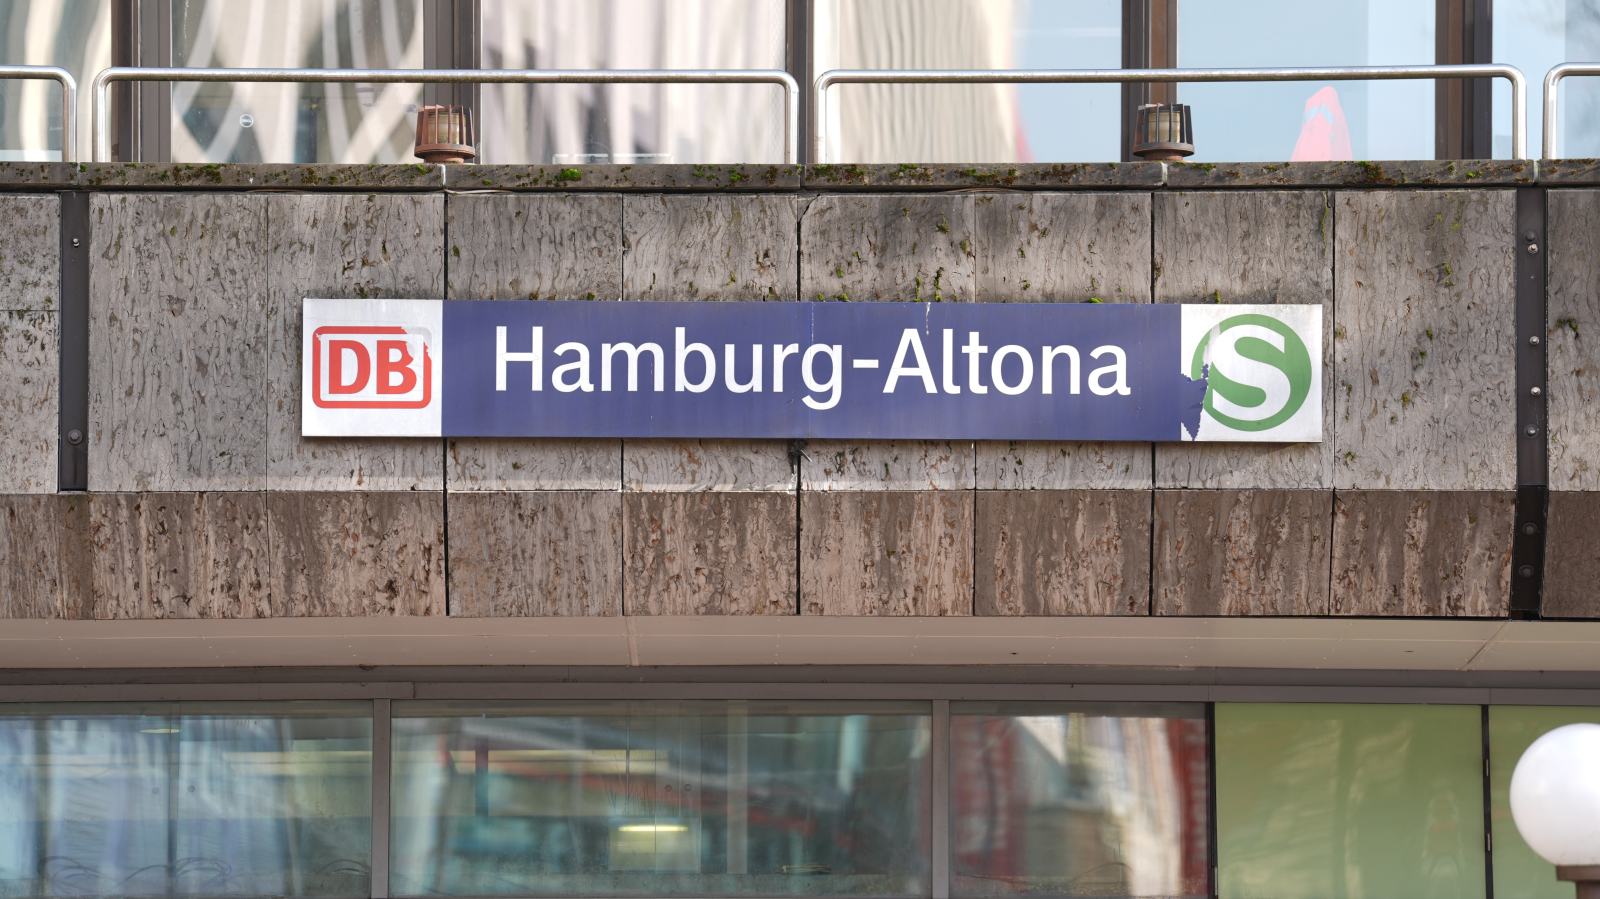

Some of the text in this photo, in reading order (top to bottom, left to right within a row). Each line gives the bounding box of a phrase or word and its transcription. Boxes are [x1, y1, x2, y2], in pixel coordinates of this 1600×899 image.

[328, 339, 418, 395] DB
[495, 325, 1132, 411] Hamburg-Altona
[1211, 323, 1292, 422] S
